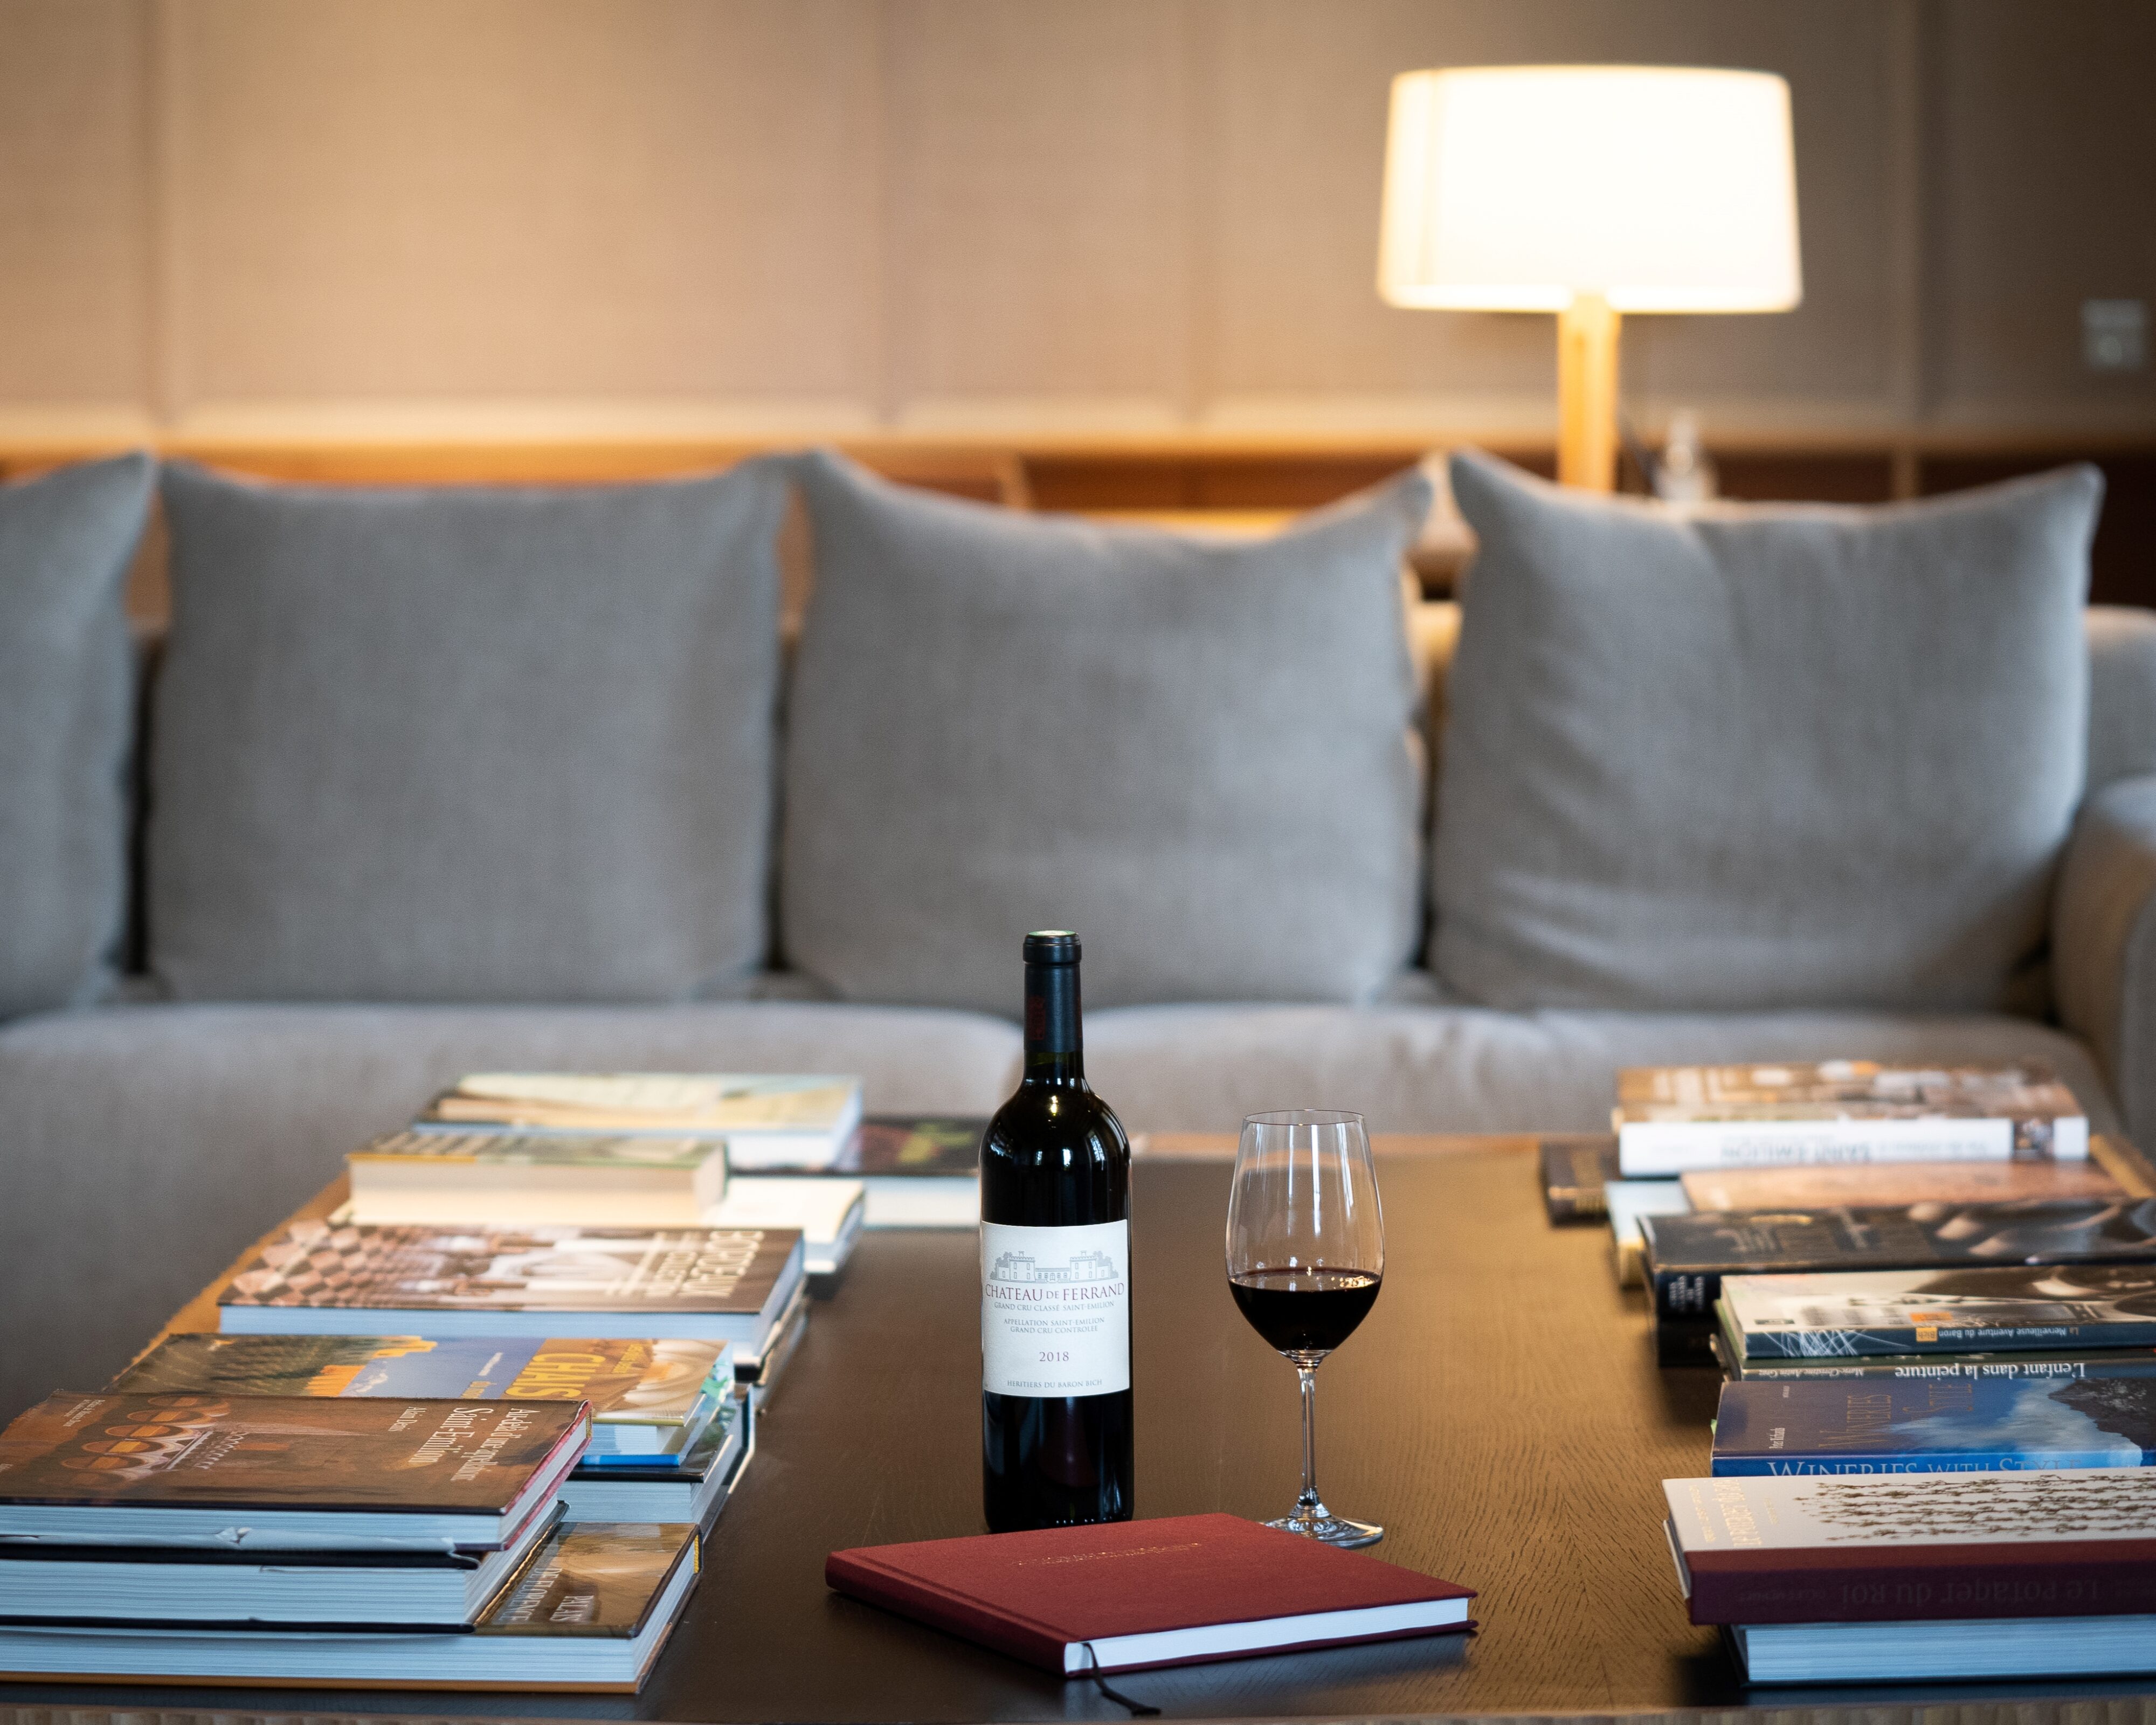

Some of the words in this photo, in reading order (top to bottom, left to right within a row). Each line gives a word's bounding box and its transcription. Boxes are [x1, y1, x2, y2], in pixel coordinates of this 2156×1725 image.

[985, 1284, 1043, 1301] CHATEAU
[1046, 1291, 1060, 1299] DE
[1062, 1282, 1125, 1301] FERRAND
[994, 1301, 1015, 1310] GRAND
[1017, 1303, 1032, 1312] CRU
[1063, 1300, 1114, 1312] SAINT-EMILION
[1004, 1318, 1048, 1326] APPELLATION
[1051, 1317, 1105, 1326] SAINT-EMILION
[1010, 1326, 1035, 1334] GRAND
[1918, 1330, 1936, 1340] Bich
[1939, 1330, 1963, 1340] Baron
[1964, 1329, 1975, 1339] du
[1978, 1328, 2014, 1338] Aventure
[2017, 1327, 2067, 1337] Merveilleuse
[1039, 1351, 1069, 1362] 2018
[505, 1353, 606, 1398] CHAIS
[1895, 1363, 1960, 1379] peinture
[1965, 1365, 1978, 1379] la
[1982, 1364, 2018, 1379] dans
[2023, 1362, 2086, 1380] L'enfant
[1007, 1379, 1041, 1388] HERITIERS
[1058, 1380, 1083, 1388] BARON
[399, 1406, 427, 1419] Alain
[388, 1419, 418, 1432] Denis
[494, 1407, 541, 1432] Au-delà
[1819, 1394, 1892, 1448] WINERIES
[408, 1407, 494, 1463] Saint-Emilion
[529, 1568, 563, 1579] DE
[499, 1580, 555, 1621] FLORENCE
[549, 1595, 595, 1622] PALAIS
